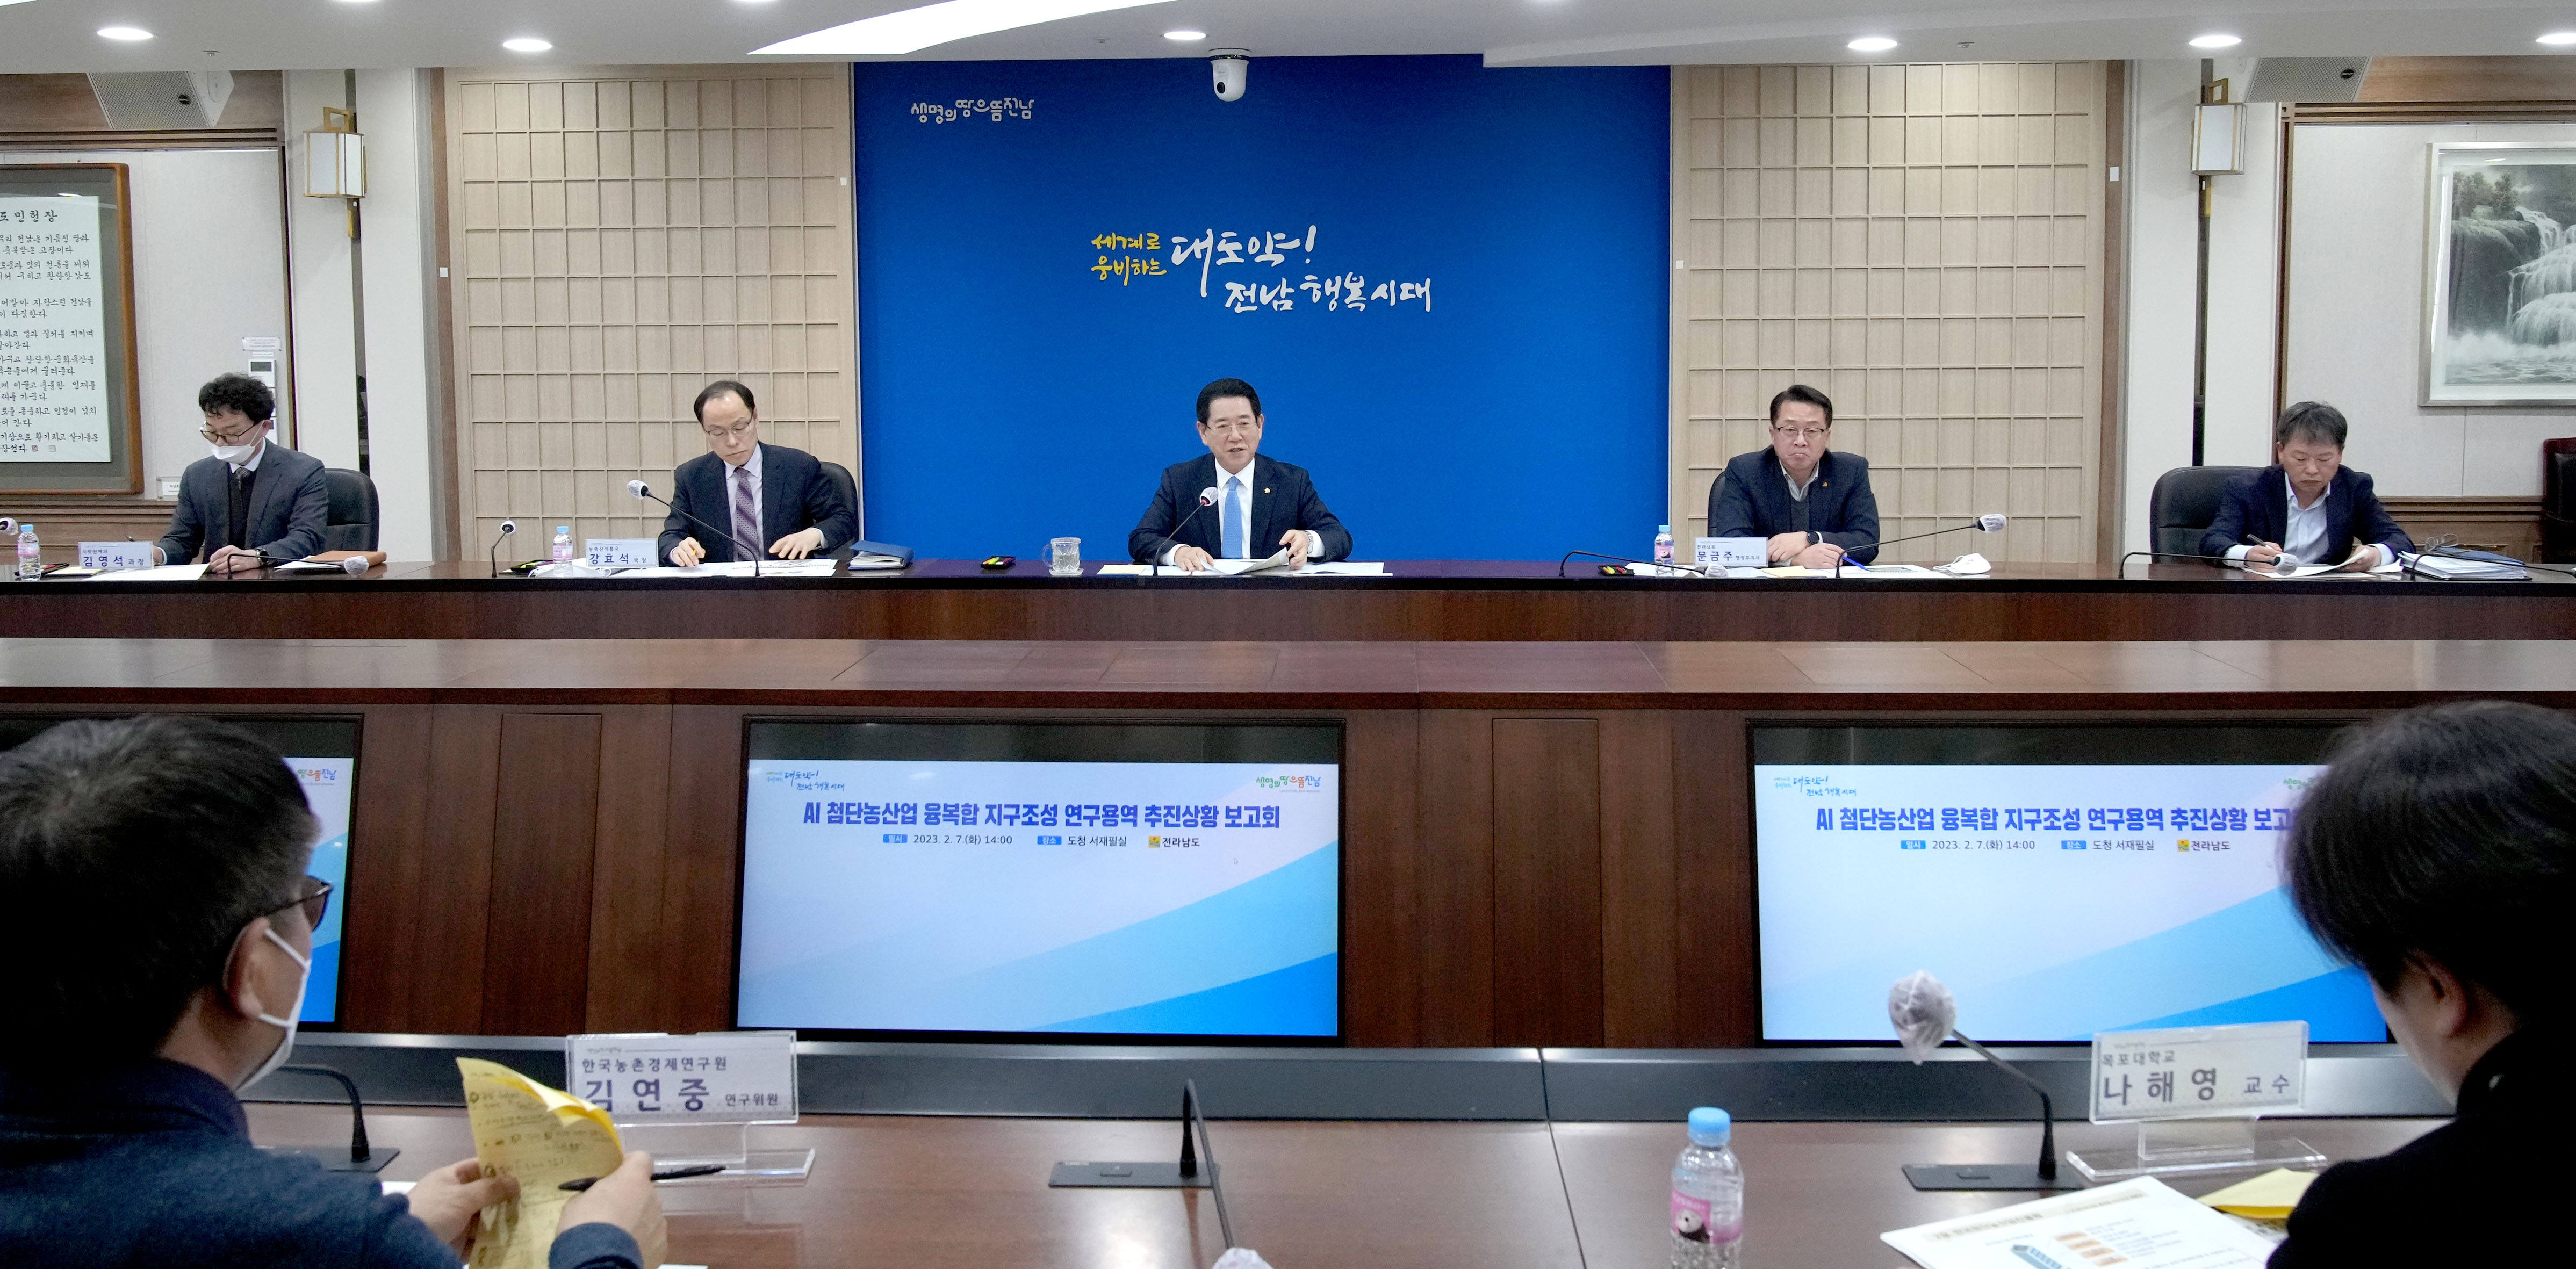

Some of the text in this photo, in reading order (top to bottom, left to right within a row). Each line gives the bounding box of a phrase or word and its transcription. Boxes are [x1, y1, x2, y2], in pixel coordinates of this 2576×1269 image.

[18, 234, 41, 243] 전남은
[45, 234, 68, 243] 기름진
[1091, 232, 1161, 251] 세계로
[3, 245, 73, 255] 축복받은 고장이다
[46, 260, 69, 269] 전통을
[1171, 225, 1317, 298] 대도약!
[47, 271, 73, 280] 찬란한
[75, 271, 91, 280] 남도
[1091, 256, 1167, 286] 웅비하는
[1225, 277, 1295, 313] 전남
[33, 297, 66, 307] 자랑스런
[70, 297, 92, 307] 전남을
[11, 309, 47, 318] 다짐한다
[0, 329, 93, 339] 하고 법과 질서를 지키며
[26, 355, 53, 364] 찬란한
[41, 366, 75, 376] 물려준다
[13, 380, 37, 390] 이끌고
[40, 380, 65, 391] 훌륭한
[72, 380, 96, 391] 인재를
[20, 392, 47, 401] 가꾼다
[18, 407, 51, 416] 존중하고
[54, 407, 76, 416] 인정이
[82, 406, 97, 415] 넘치
[13, 418, 32, 428] 간다
[0, 444, 27, 453] 장선다
[83, 556, 123, 567] 김영석
[589, 553, 629, 565] 강효석
[1697, 551, 1733, 561] 문금주
[803, 802, 1280, 828] AI 첨단농산업 융복합 지구조성 연구용역 추진상황 보고회
[1816, 807, 2298, 831] AI 첨단농산업 융복합 지구조성 연구용역 추진상황 보고
[889, 834, 1012, 845] 일시 2023. 2. 7.(화) 14:00
[1068, 836, 1086, 846] 도청
[1090, 836, 1127, 847] 서재필실
[1162, 837, 1200, 847] 전라남도
[1906, 840, 2035, 850] 일시 2023. 2. 7.(화) 14:00
[2093, 840, 2112, 850] 도청
[2116, 840, 2155, 850] 서재필실
[2191, 840, 2230, 851] 전라남도
[582, 1056, 727, 1073] 한국농촌경제연구원
[2102, 1050, 2175, 1068] 목포대학교
[2103, 1068, 2290, 1105] 나해영 교수
[585, 1078, 779, 1112] 김연중 연구위원
